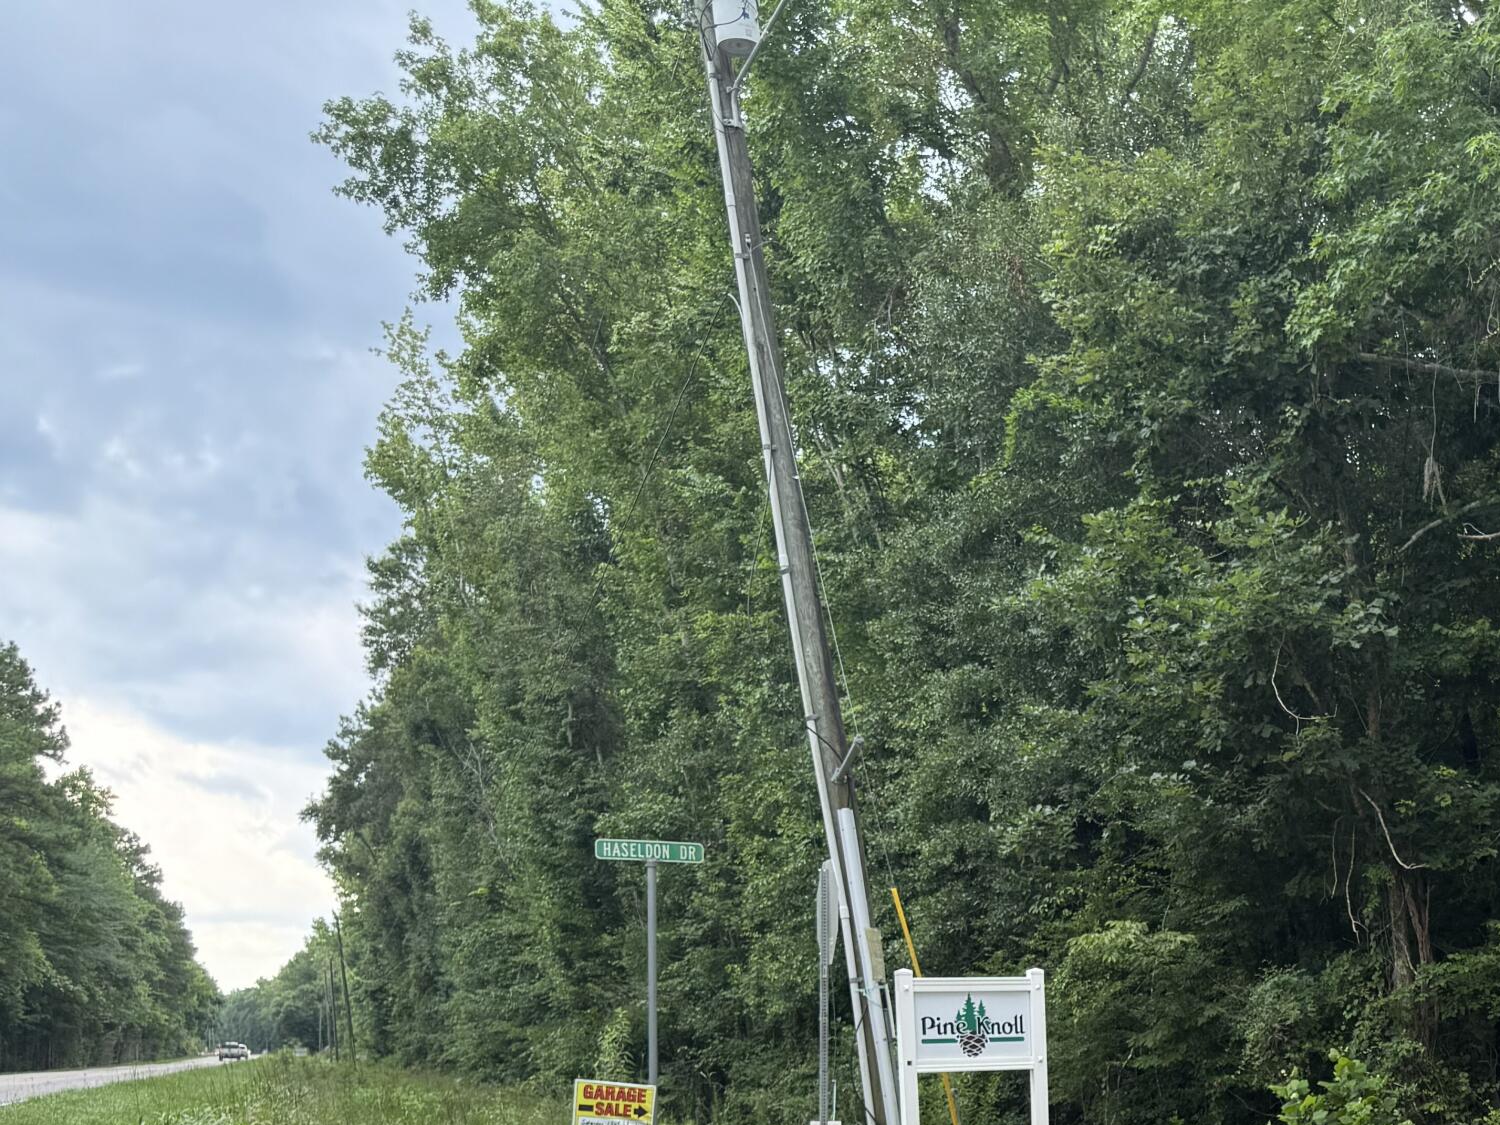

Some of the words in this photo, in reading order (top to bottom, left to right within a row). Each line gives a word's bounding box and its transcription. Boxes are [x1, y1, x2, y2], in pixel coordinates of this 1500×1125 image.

[603, 842, 670, 859] HASELDON
[680, 846, 696, 861] DR
[921, 1016, 967, 1035] Pine
[976, 1014, 1025, 1035] Knoll
[583, 1085, 647, 1103] GARAGE
[595, 1102, 632, 1117] SALE
